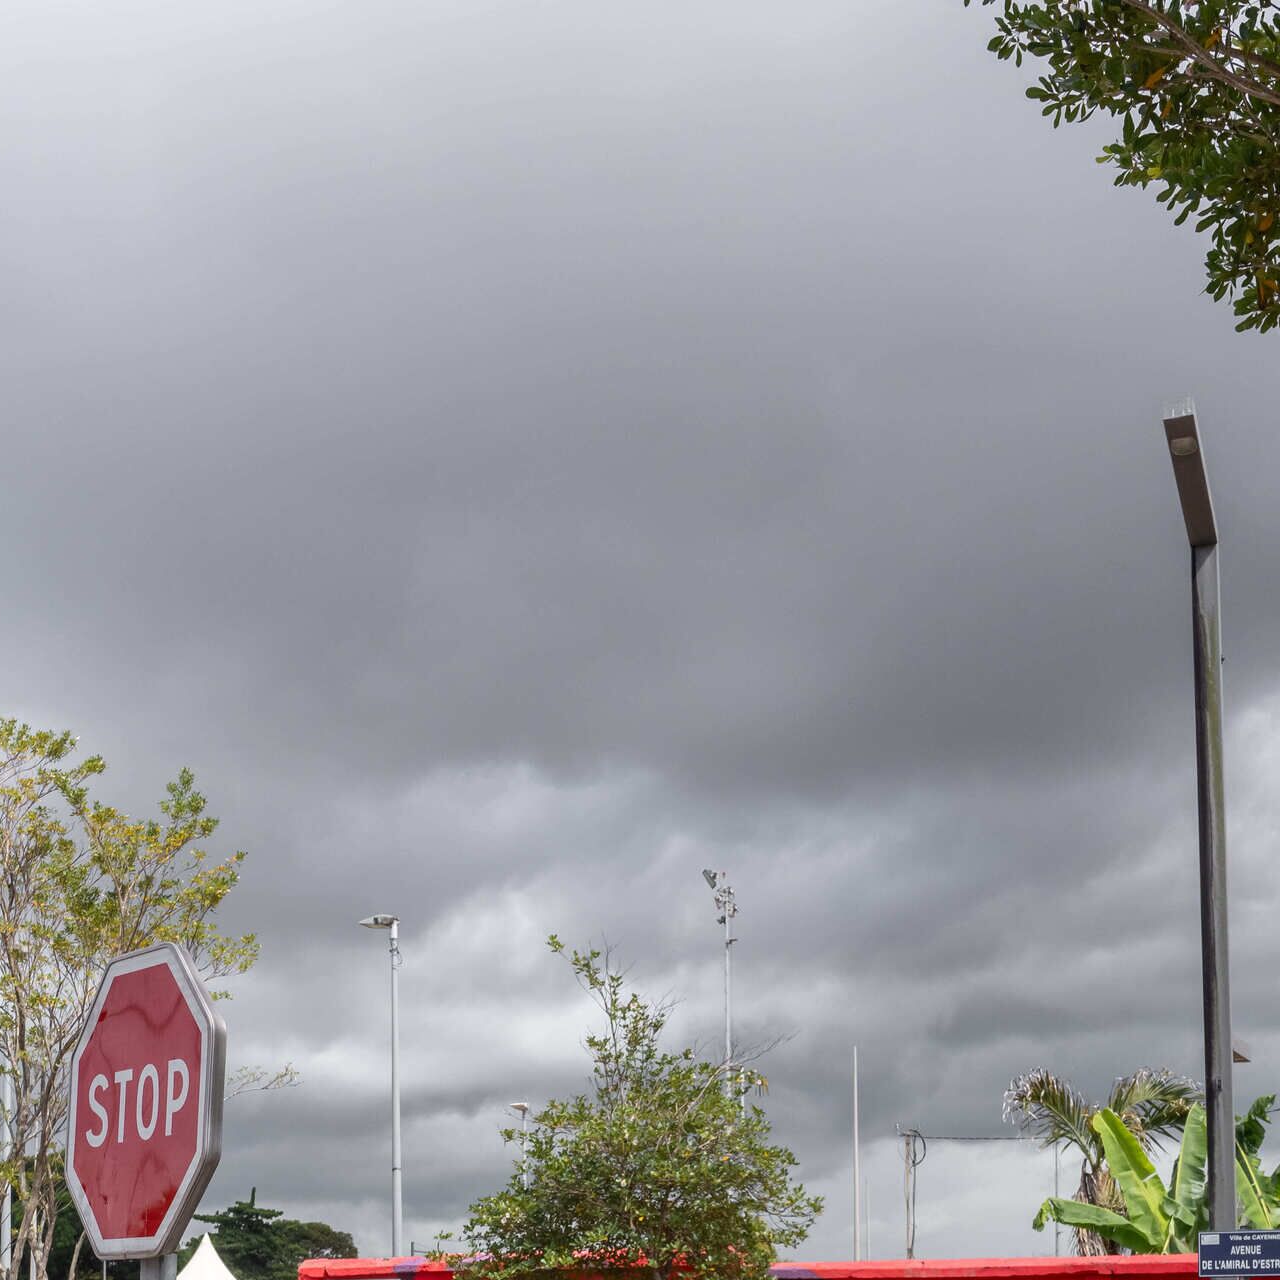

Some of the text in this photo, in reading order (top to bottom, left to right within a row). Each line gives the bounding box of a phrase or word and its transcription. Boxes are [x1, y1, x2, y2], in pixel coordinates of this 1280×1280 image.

[86, 1059, 190, 1148] STOP
[1251, 1233, 1280, 1241] CAYENNE
[1230, 1245, 1262, 1255] AVENUE
[1201, 1260, 1213, 1270] DE
[1214, 1259, 1250, 1270] L'AMIRAL
